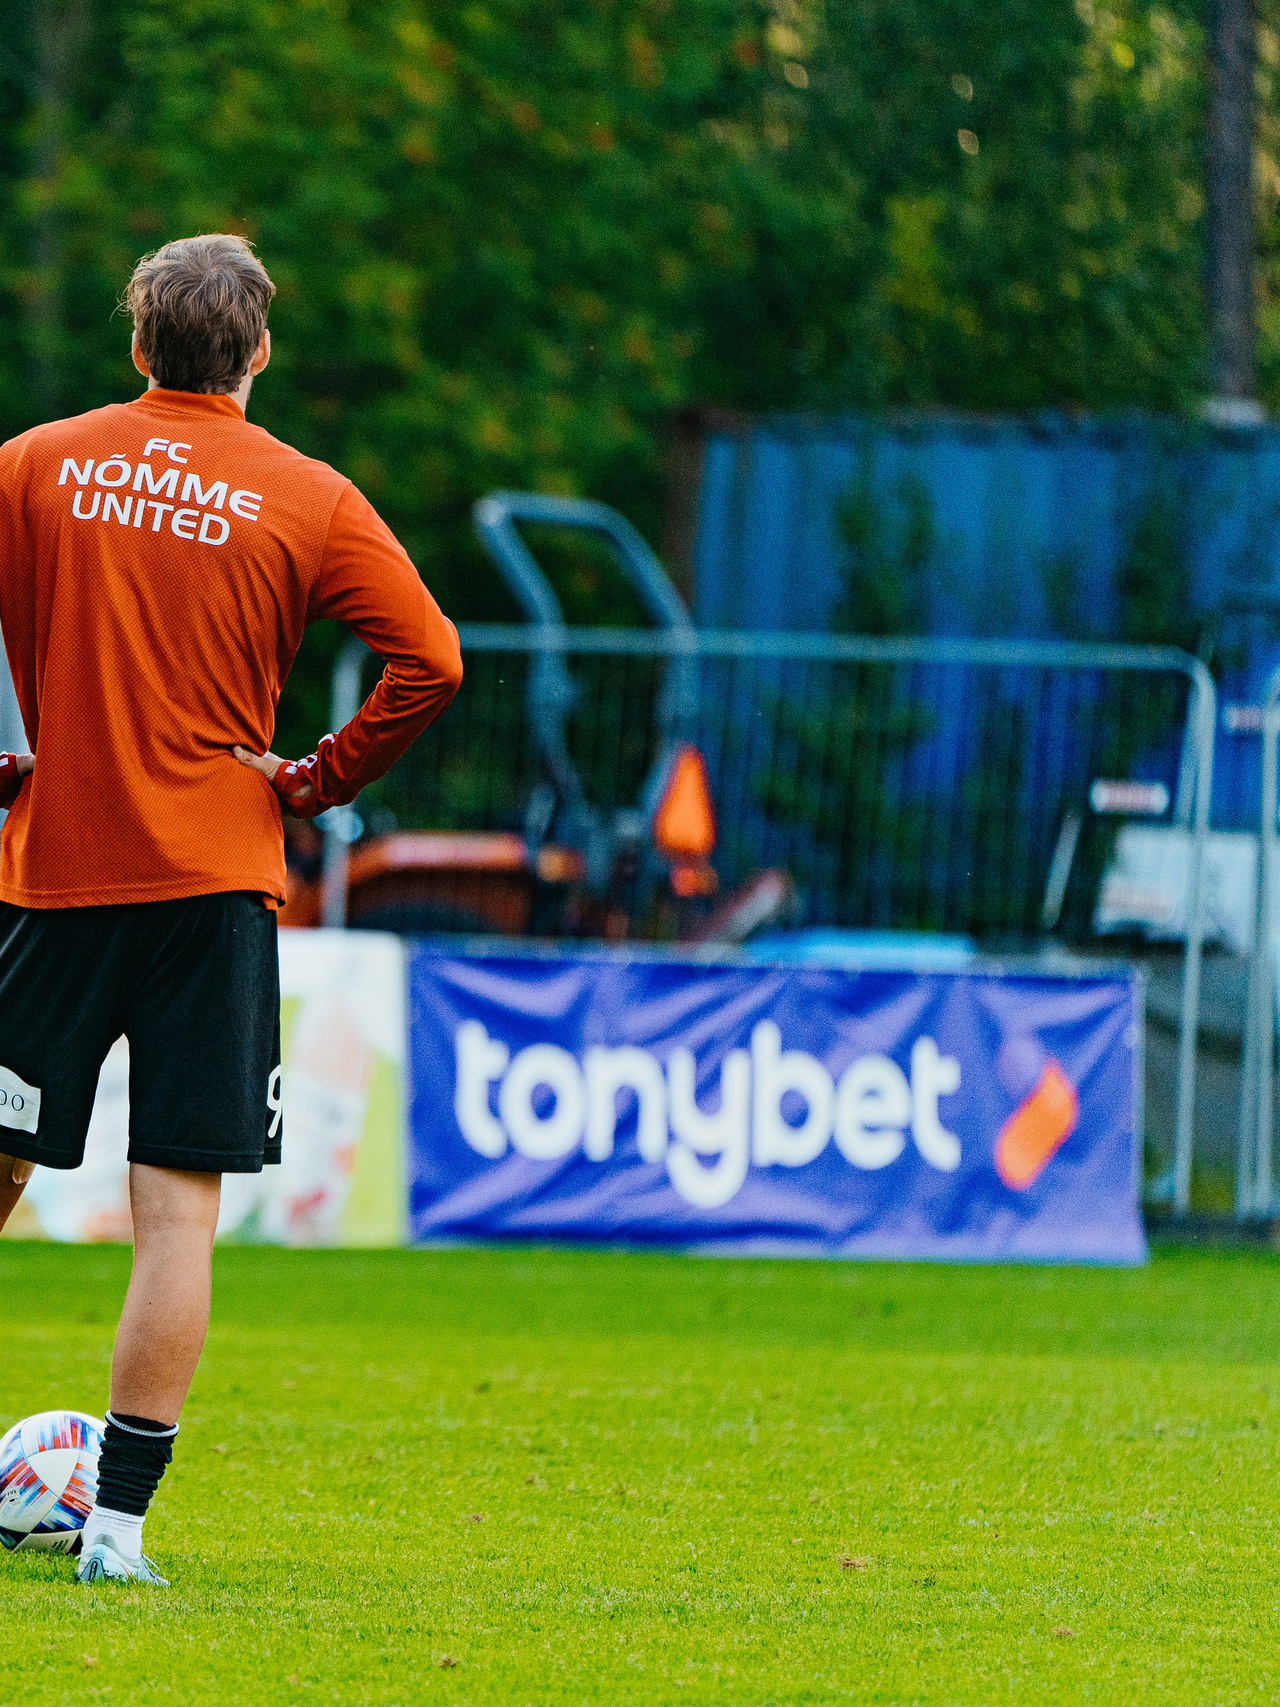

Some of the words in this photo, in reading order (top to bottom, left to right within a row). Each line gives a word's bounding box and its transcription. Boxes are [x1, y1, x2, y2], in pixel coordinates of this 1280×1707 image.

[142, 437, 193, 464] FC
[57, 453, 264, 522] NÕMME
[72, 490, 231, 546] UNITED
[455, 1018, 962, 1208] tonybet
